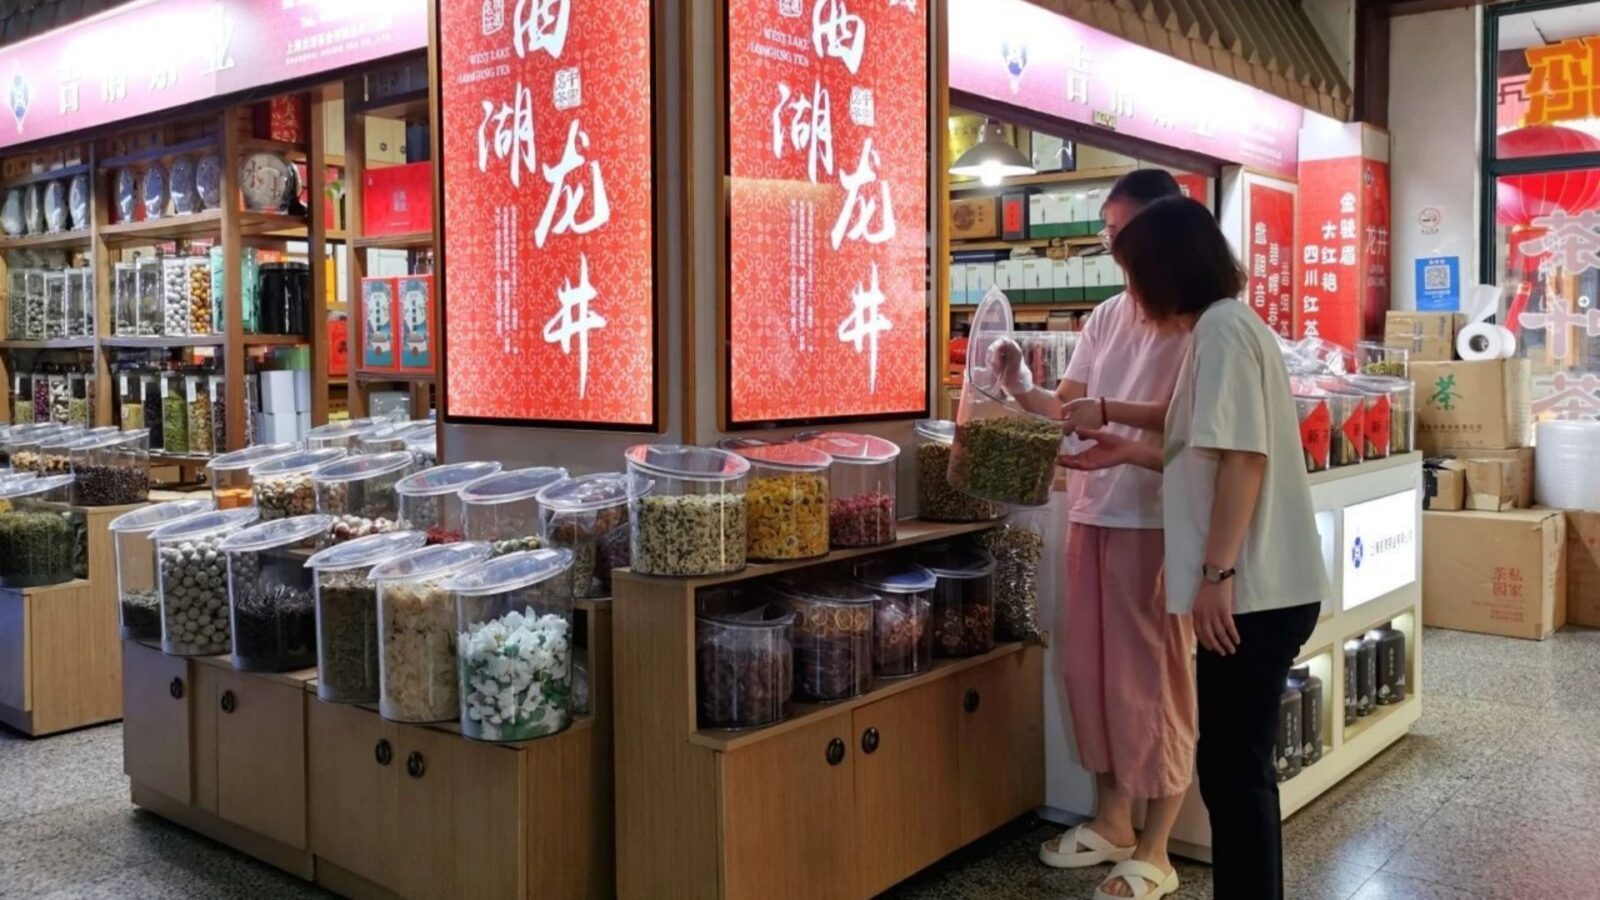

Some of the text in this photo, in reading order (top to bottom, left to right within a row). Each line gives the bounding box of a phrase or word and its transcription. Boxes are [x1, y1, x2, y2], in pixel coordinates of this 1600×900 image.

[1303, 245, 1319, 339] 四川红茶
[1321, 220, 1338, 292] 大红袍
[1427, 373, 1463, 411] 茶
